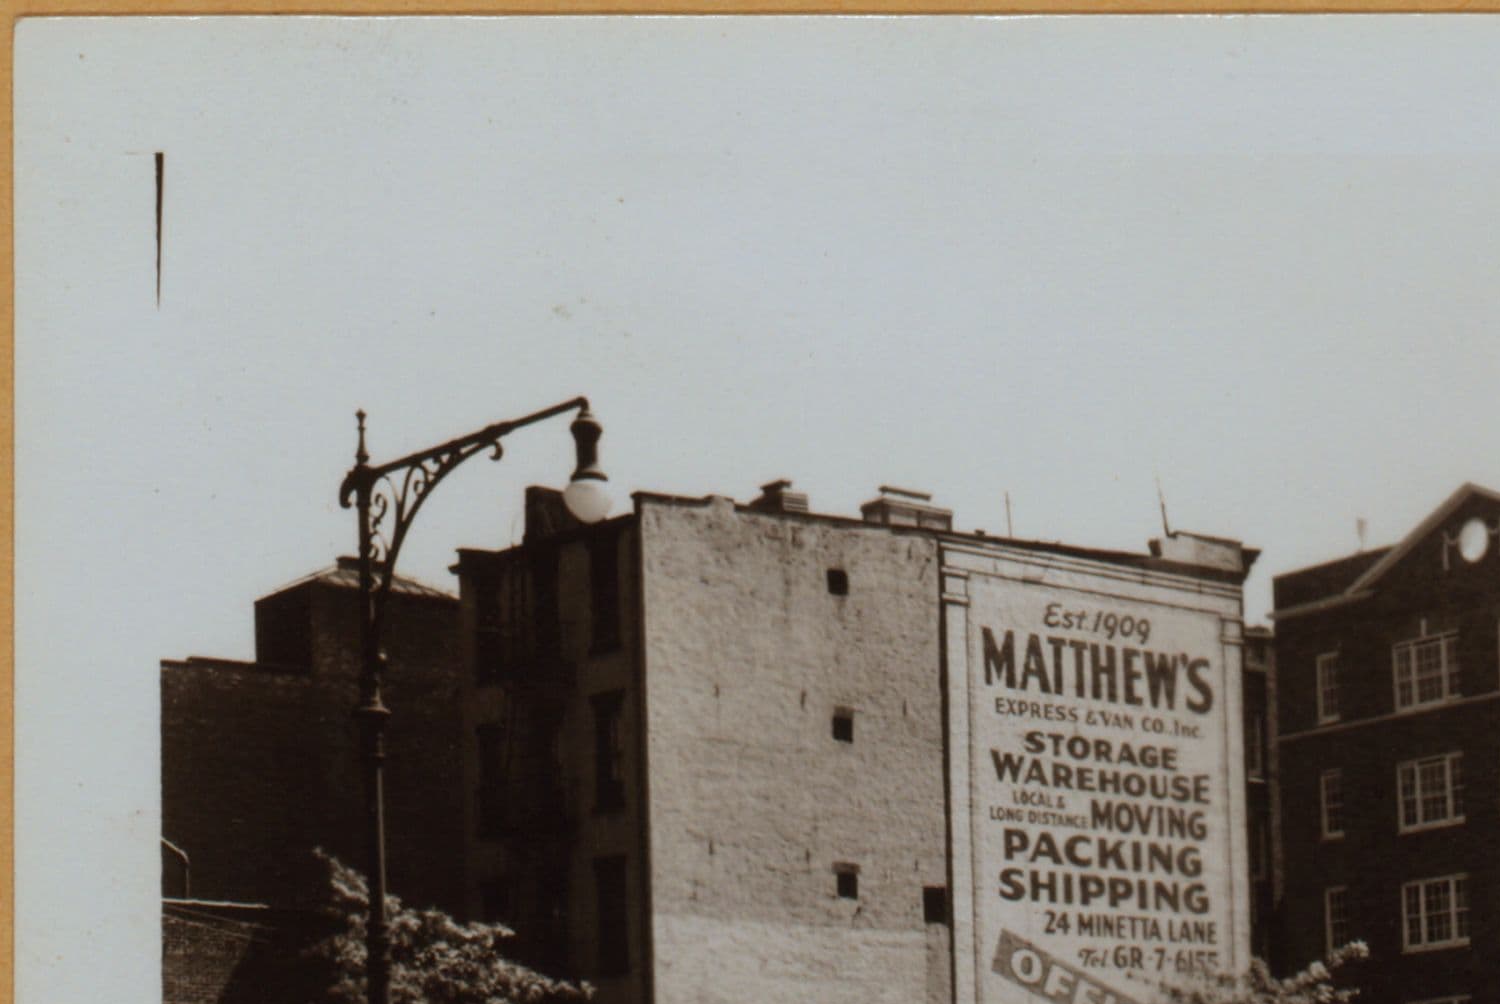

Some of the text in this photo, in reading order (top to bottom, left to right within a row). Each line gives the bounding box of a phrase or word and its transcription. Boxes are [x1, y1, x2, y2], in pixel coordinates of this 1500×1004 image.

[1092, 610, 1151, 646] 1909
[981, 626, 1214, 715] MATTHEW'S
[995, 697, 1079, 722] EXPRESS
[1085, 710, 1098, 726] &
[1099, 711, 1134, 730] VAN
[1023, 730, 1178, 771] STORAGE
[989, 748, 1211, 805] WAREHOUSE
[989, 805, 1089, 829] LONG DISTANCE
[1012, 789, 1065, 809] LOCAL &
[1090, 799, 1207, 841] MOVING
[1003, 827, 1203, 878] PACKING
[999, 868, 1210, 915] SHIPPING
[1044, 910, 1218, 945] 24 MINETTA LANE
